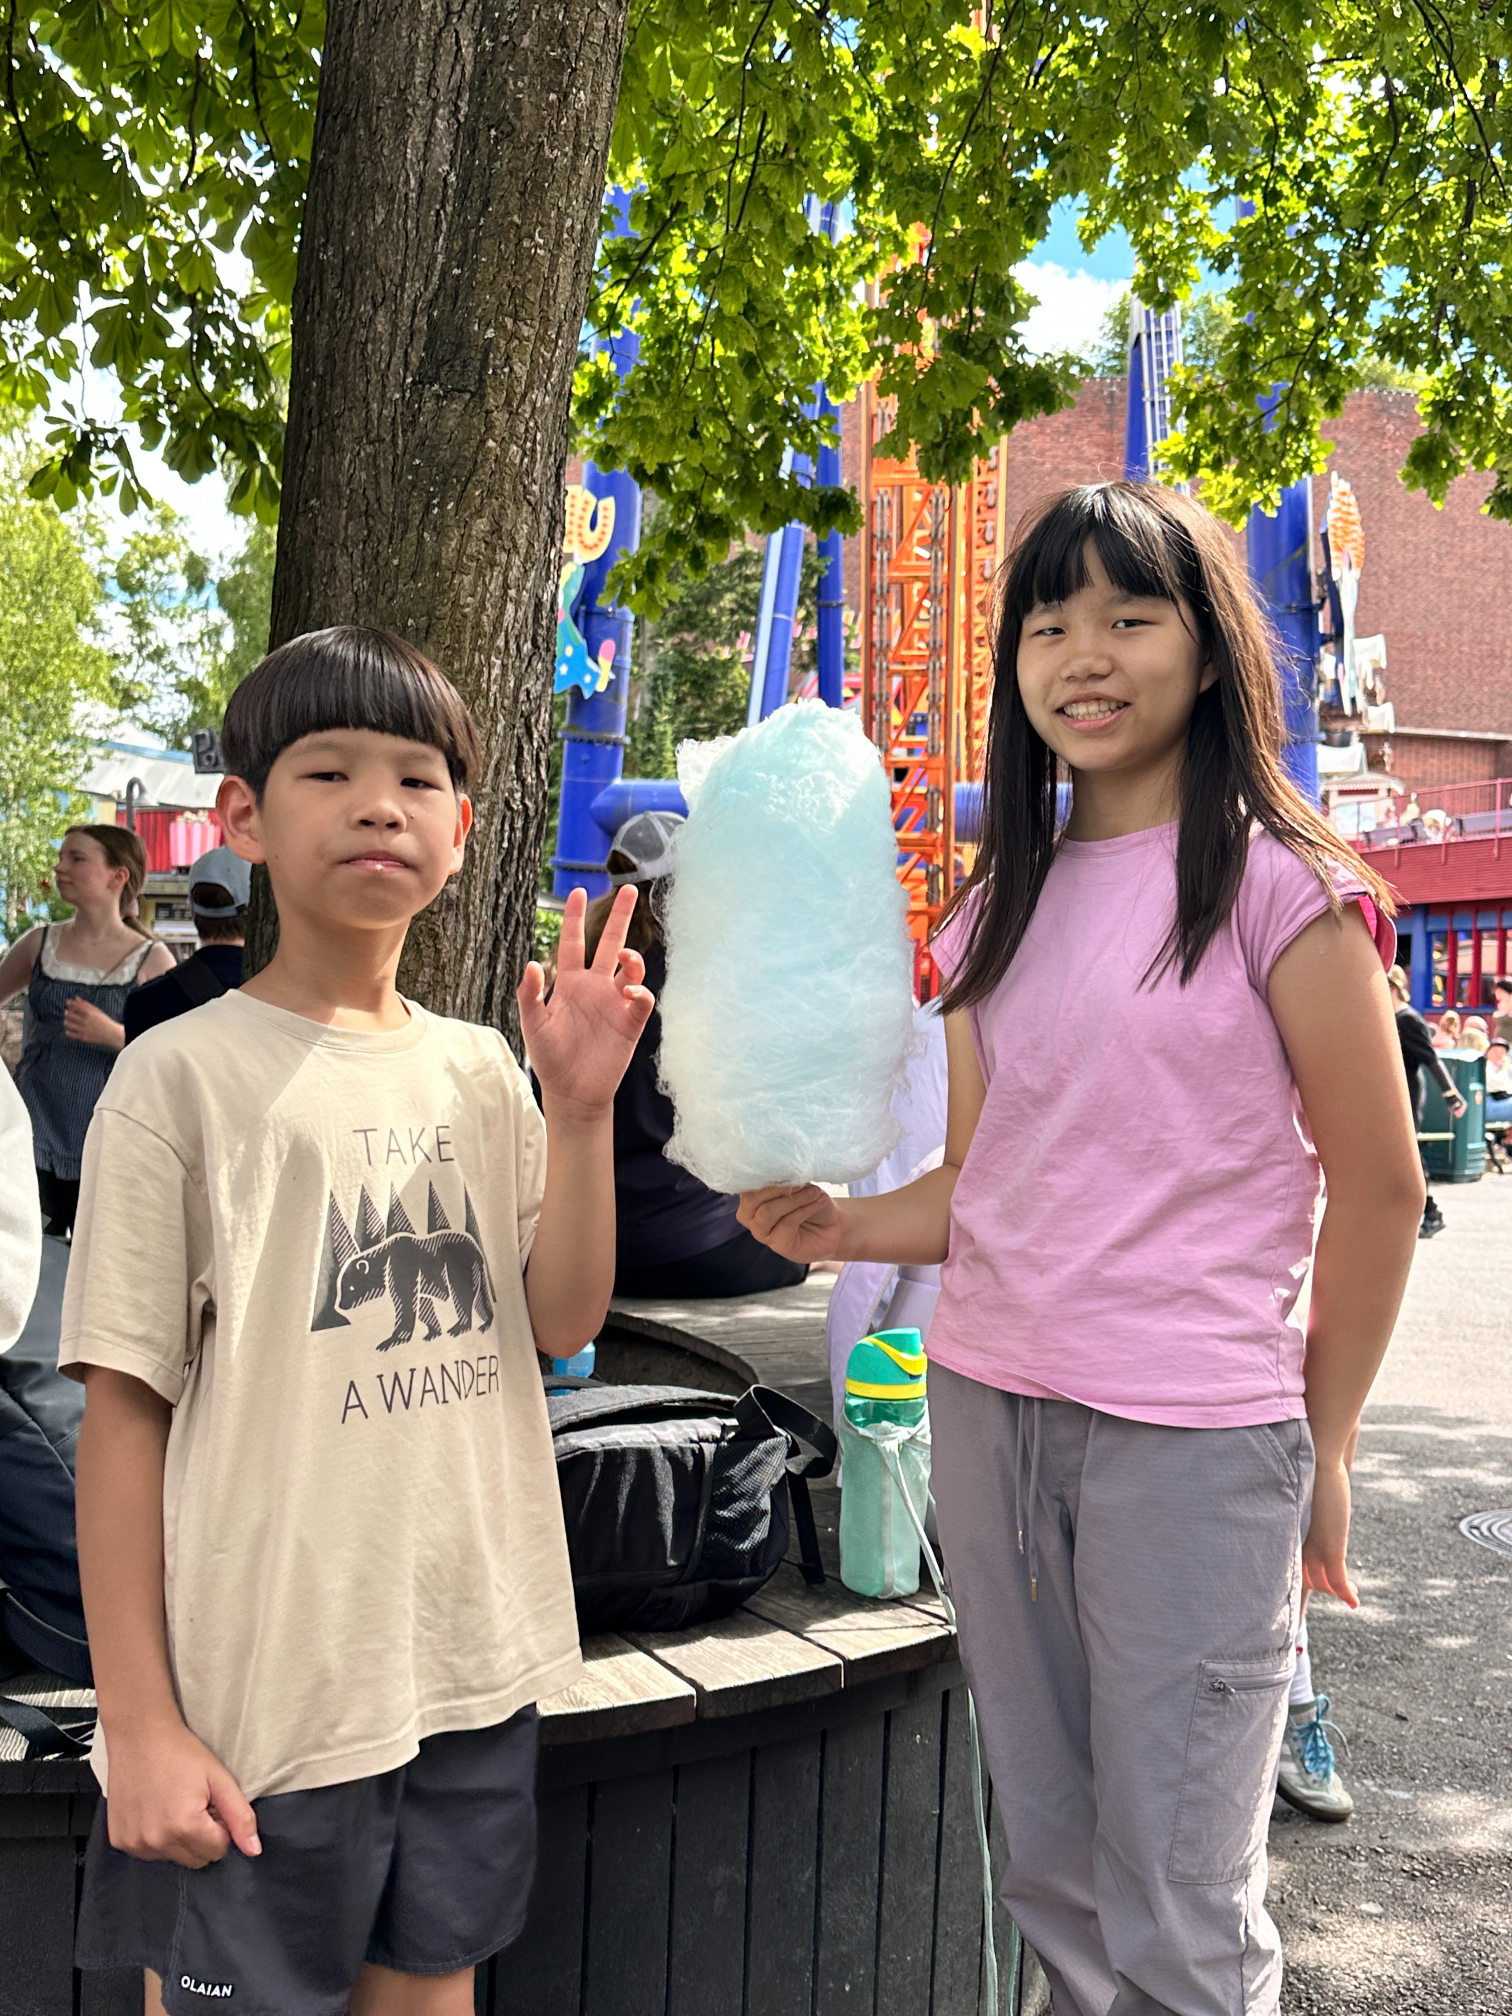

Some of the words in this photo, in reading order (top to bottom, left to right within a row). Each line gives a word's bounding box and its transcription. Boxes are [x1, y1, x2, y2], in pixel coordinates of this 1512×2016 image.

[352, 1125, 454, 1166] TAKE
[341, 1379, 368, 1424] A
[376, 1354, 500, 1413] WANDER
[180, 1975, 233, 1997] OLAIAN
